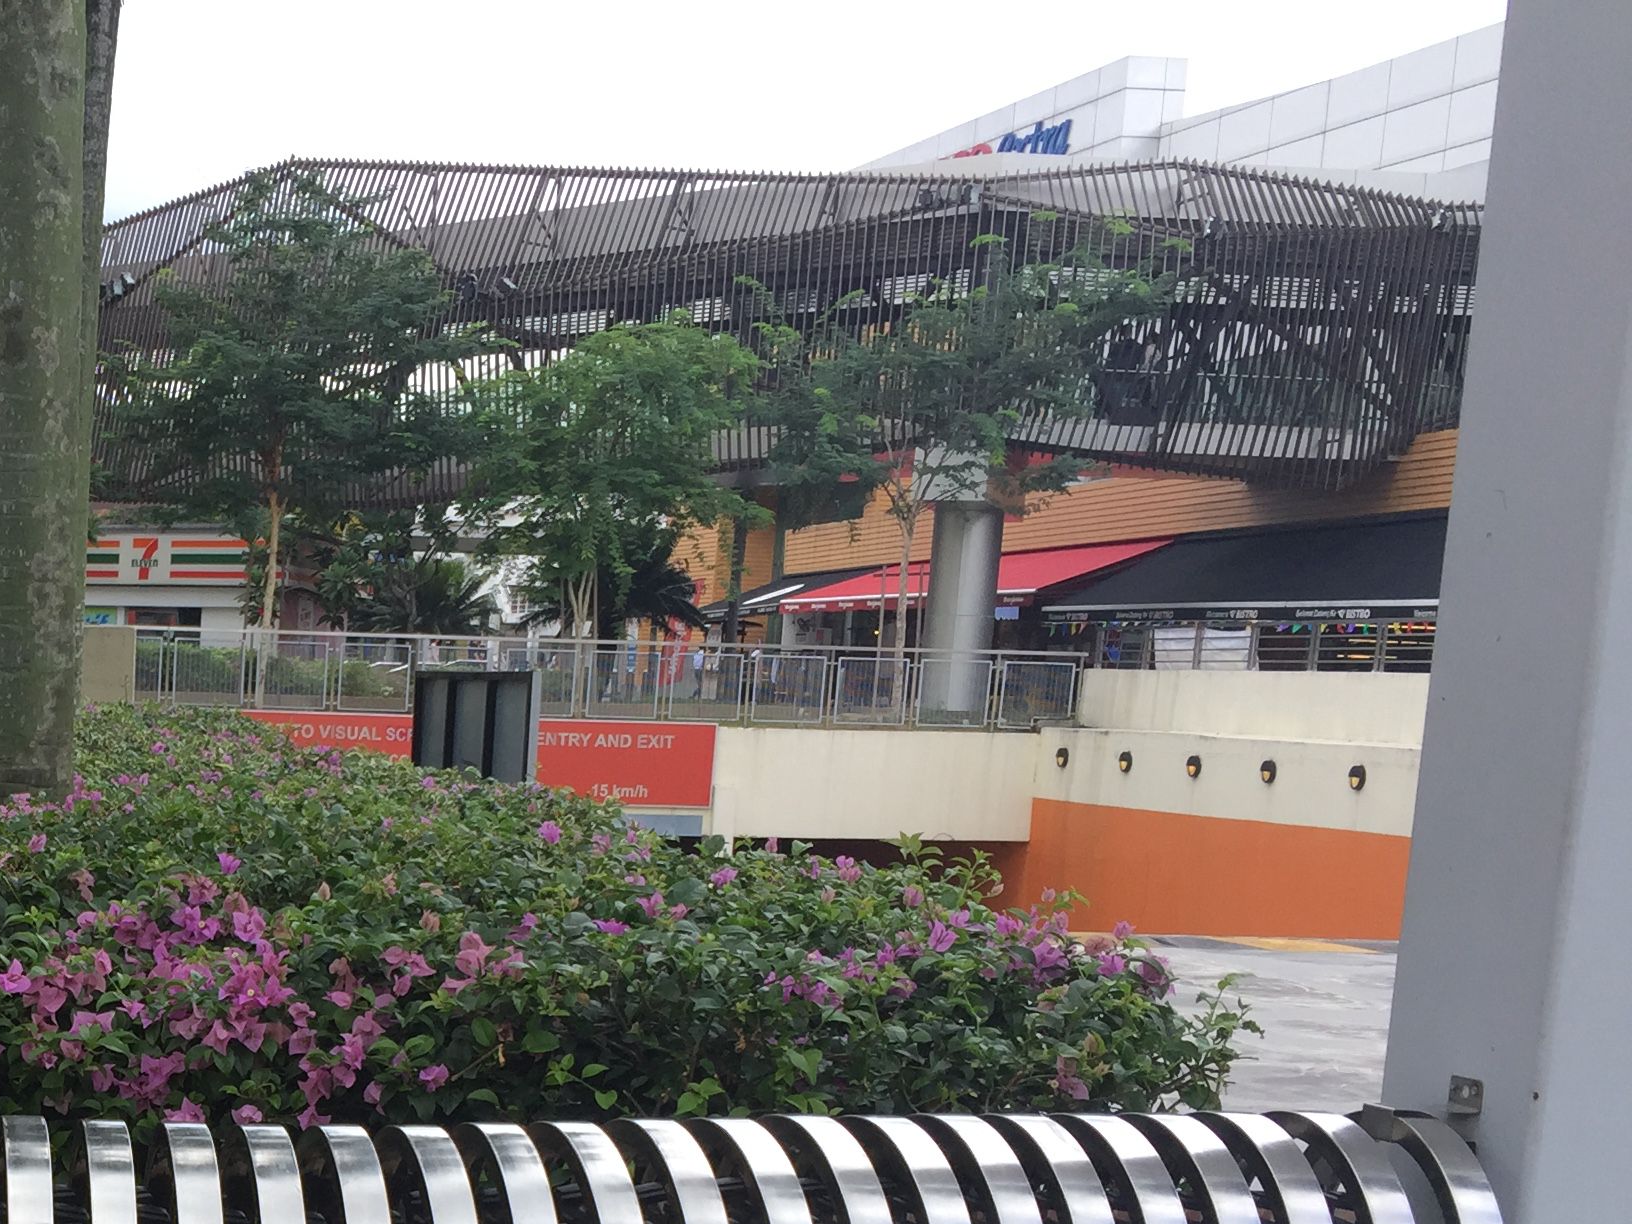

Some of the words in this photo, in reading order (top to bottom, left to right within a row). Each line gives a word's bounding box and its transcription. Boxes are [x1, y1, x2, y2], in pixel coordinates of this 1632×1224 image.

[132, 538, 159, 580] 7
[292, 723, 314, 739] TO
[319, 725, 381, 741] VISUAL
[594, 734, 632, 748] AND
[636, 735, 675, 749] EXIT
[591, 784, 608, 797] 15
[612, 784, 648, 798] km/h
